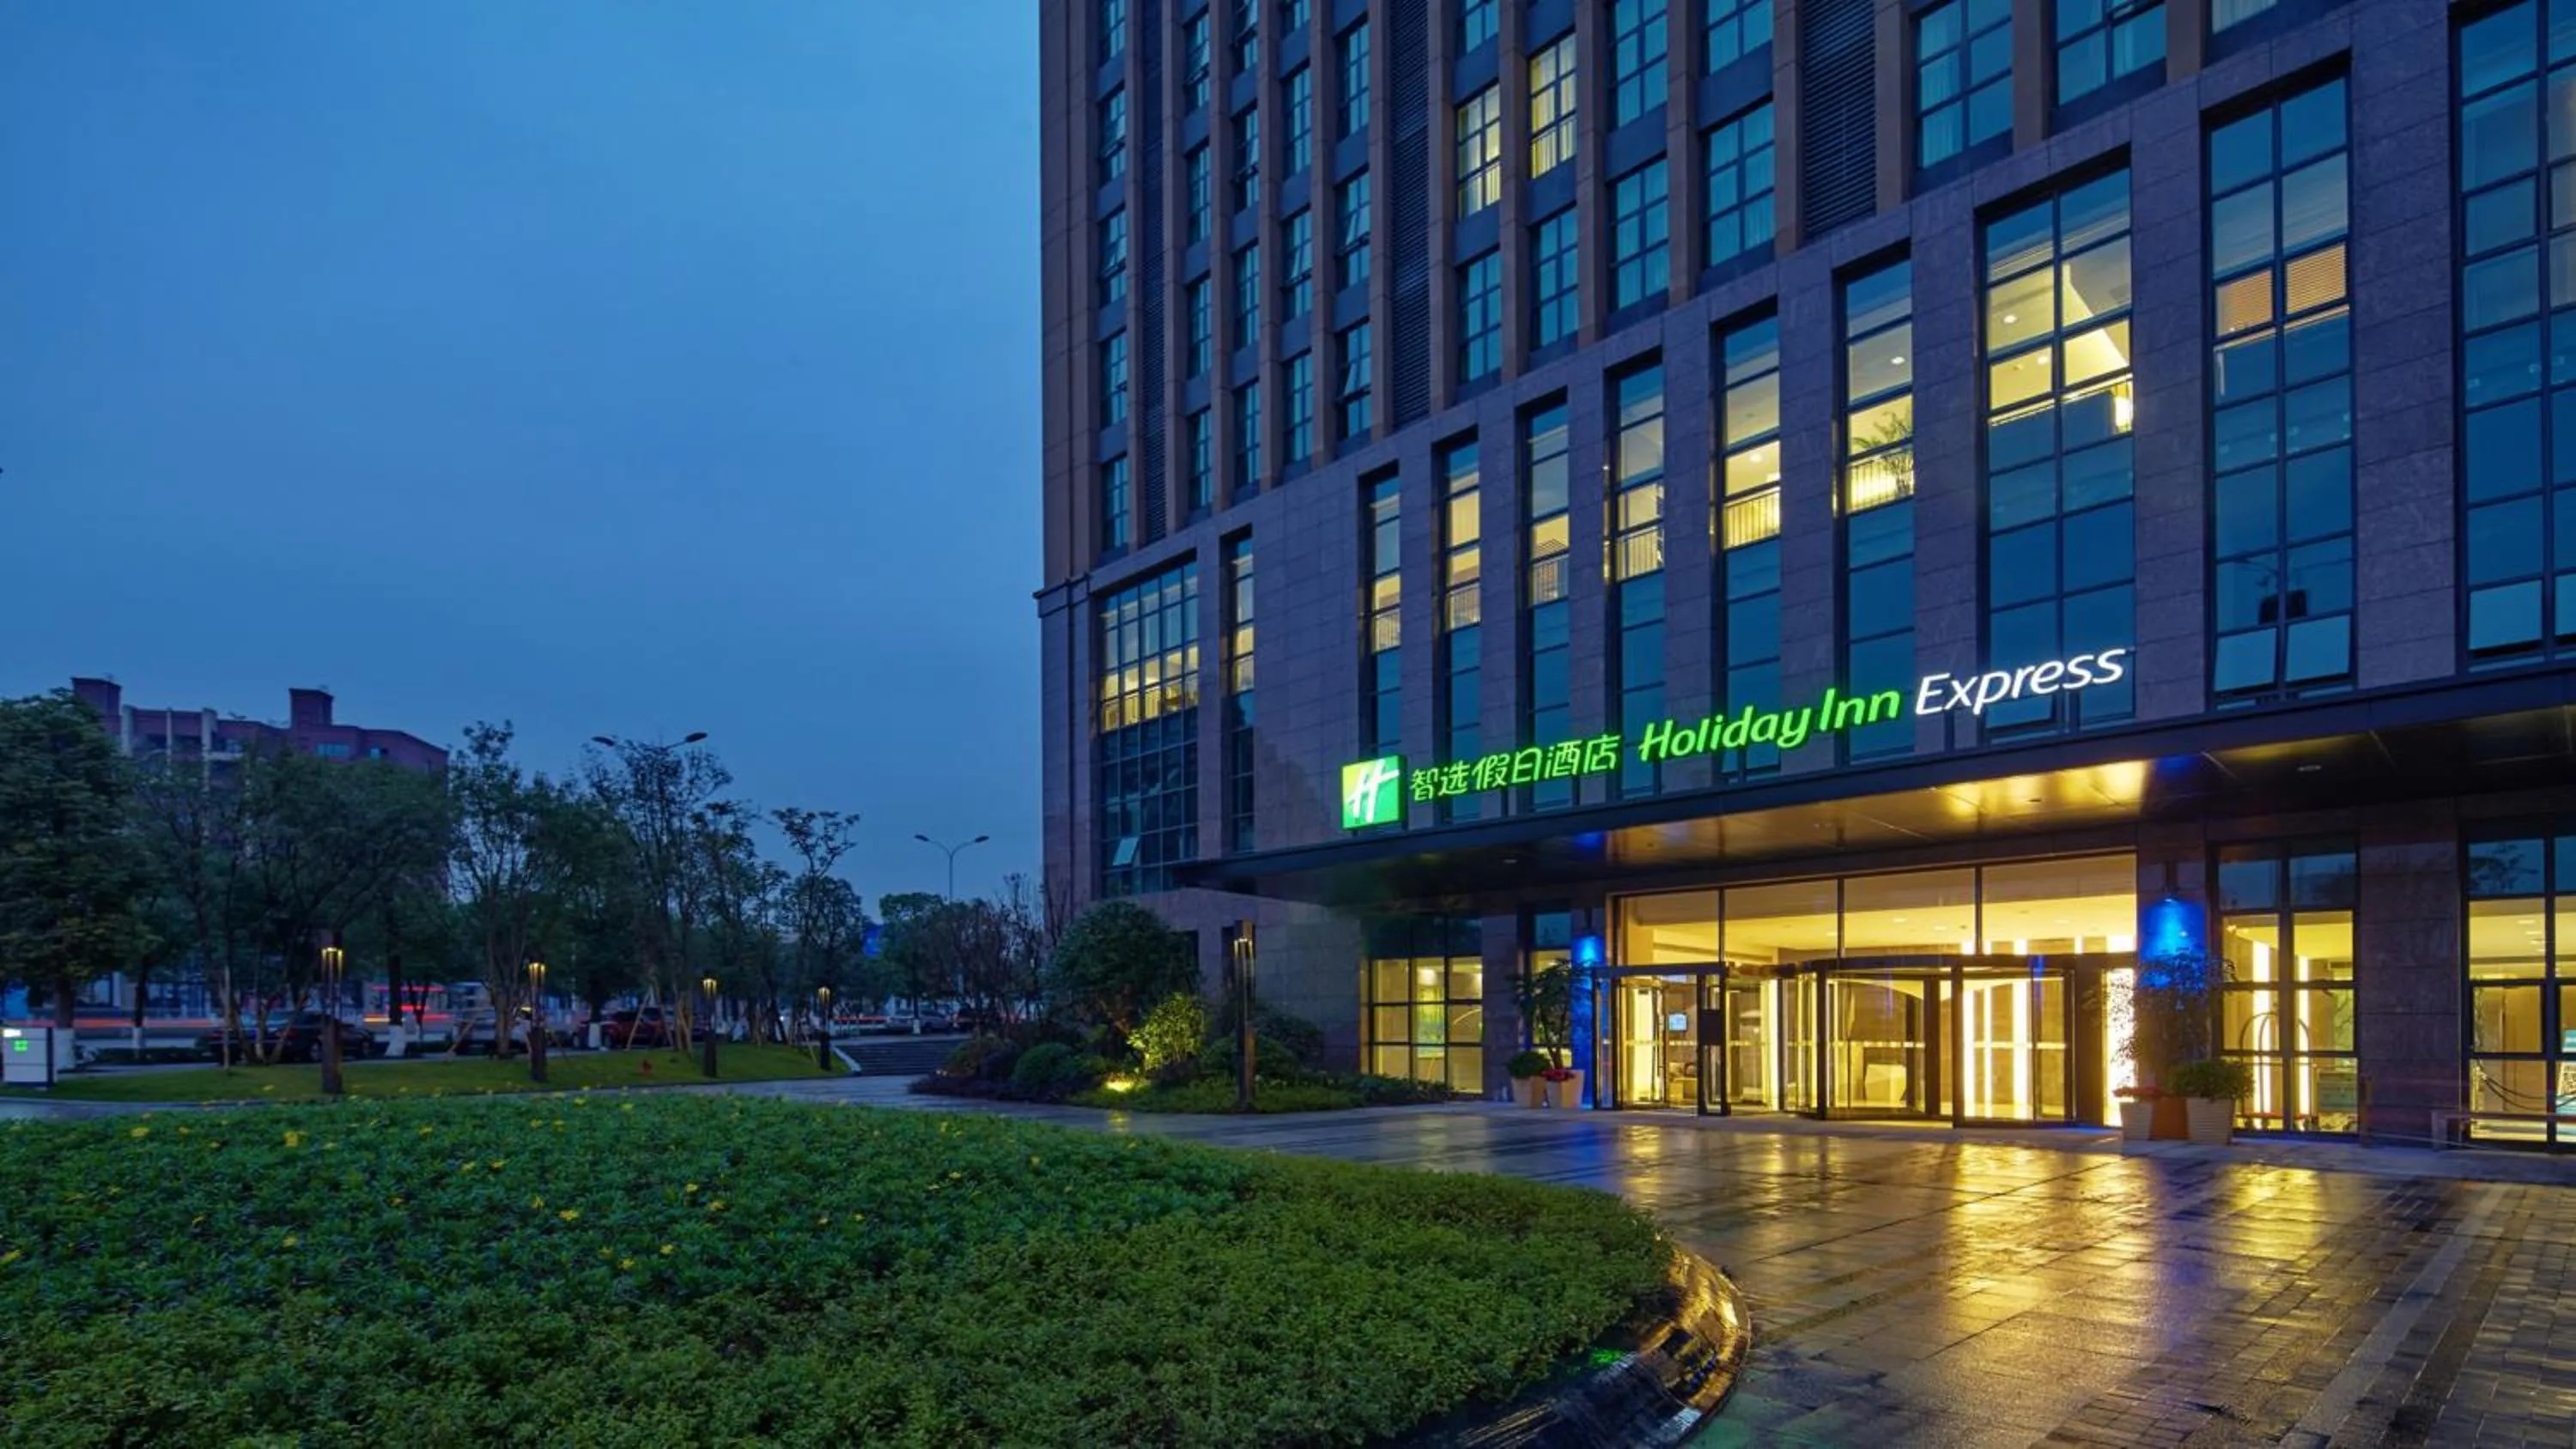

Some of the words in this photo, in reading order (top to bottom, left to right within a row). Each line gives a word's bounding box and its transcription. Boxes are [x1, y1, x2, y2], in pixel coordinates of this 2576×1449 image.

[1638, 705, 1812, 762] Holiday
[1819, 688, 1901, 731] Inn
[1915, 648, 2126, 715] Express
[1410, 734, 1621, 802] 智选假日酒店
